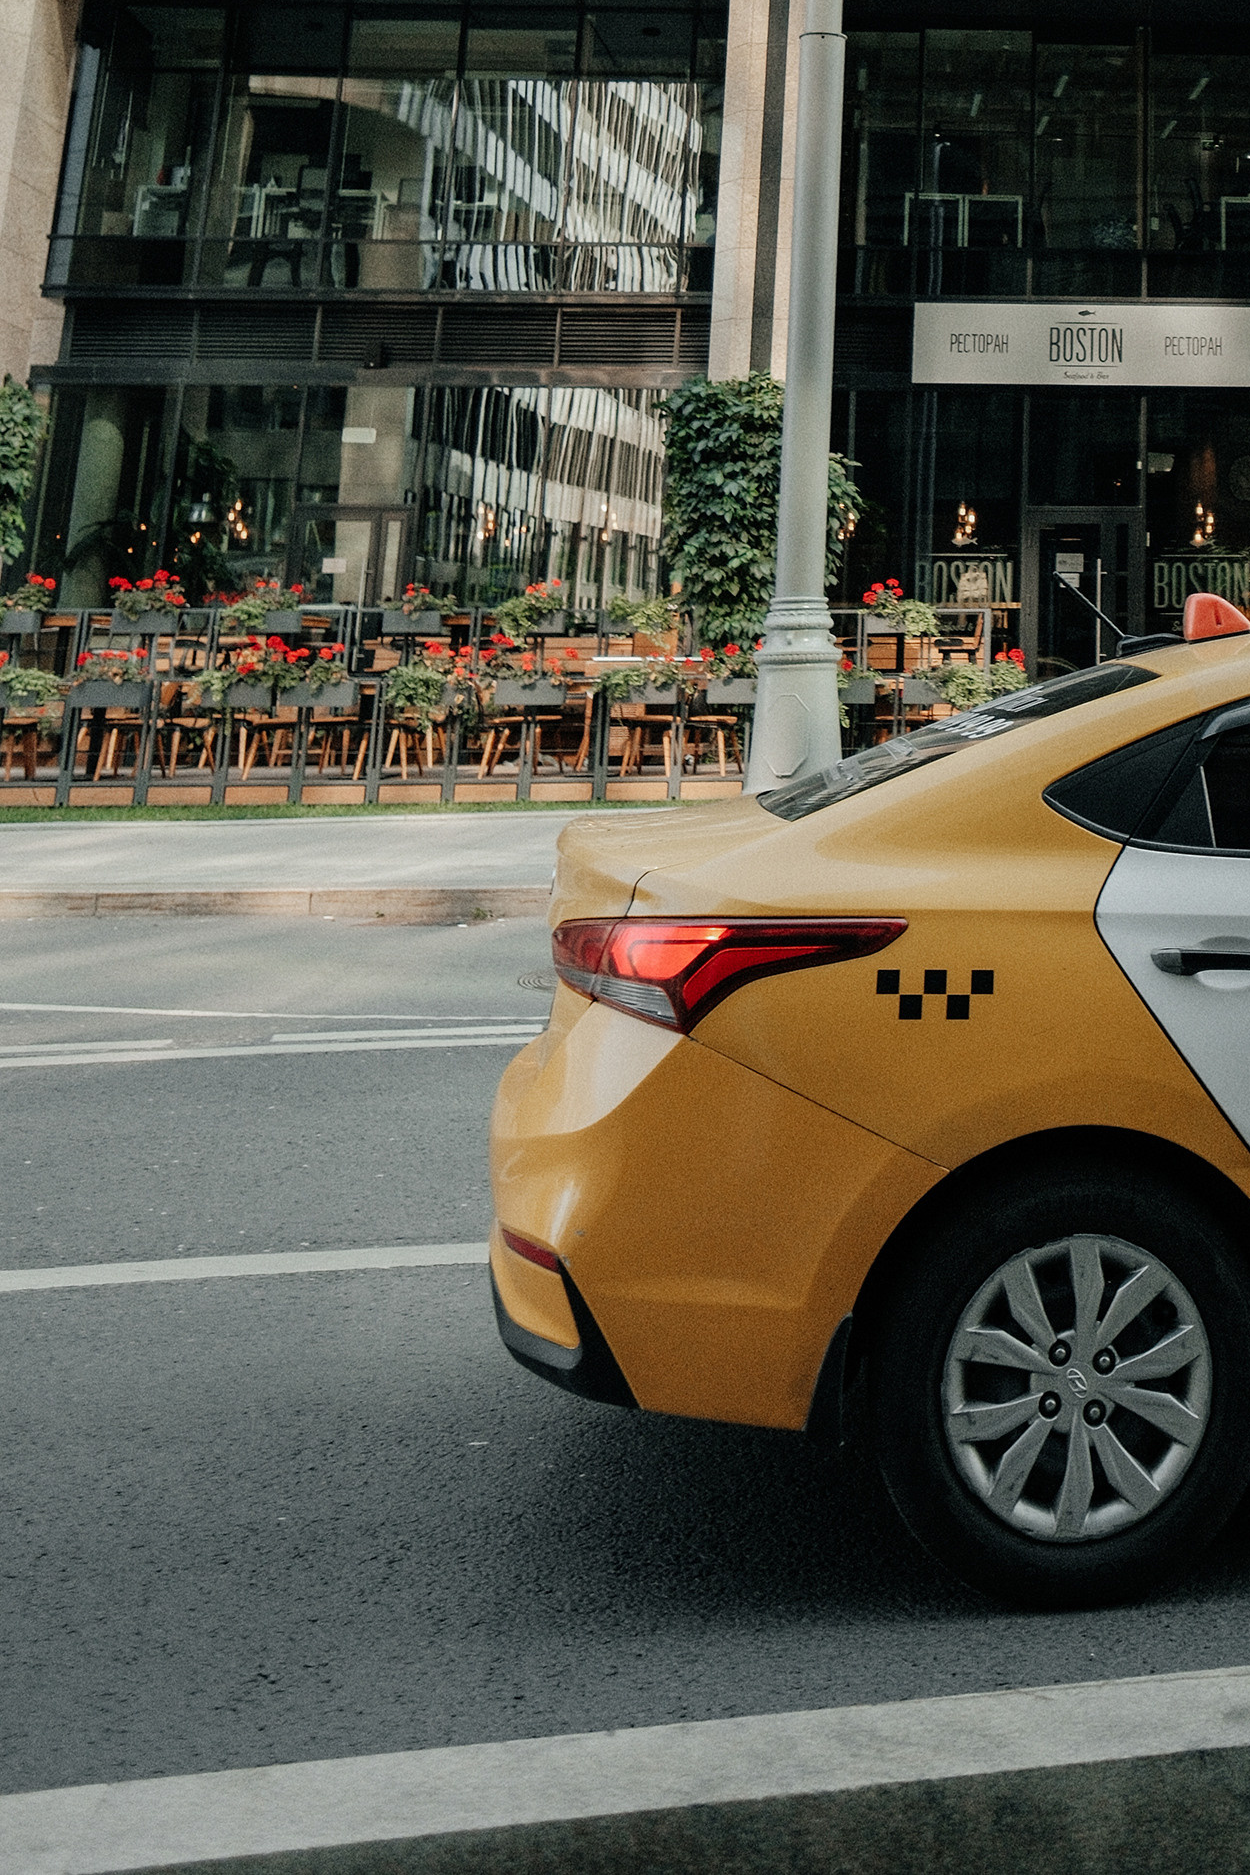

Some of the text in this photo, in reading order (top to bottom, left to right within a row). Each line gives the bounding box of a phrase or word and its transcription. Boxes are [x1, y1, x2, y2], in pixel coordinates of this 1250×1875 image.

[949, 333, 1009, 354] РЕСТОРАН
[1049, 327, 1123, 363] BOSTON
[1164, 336, 1223, 356] РЕСТОРАН
